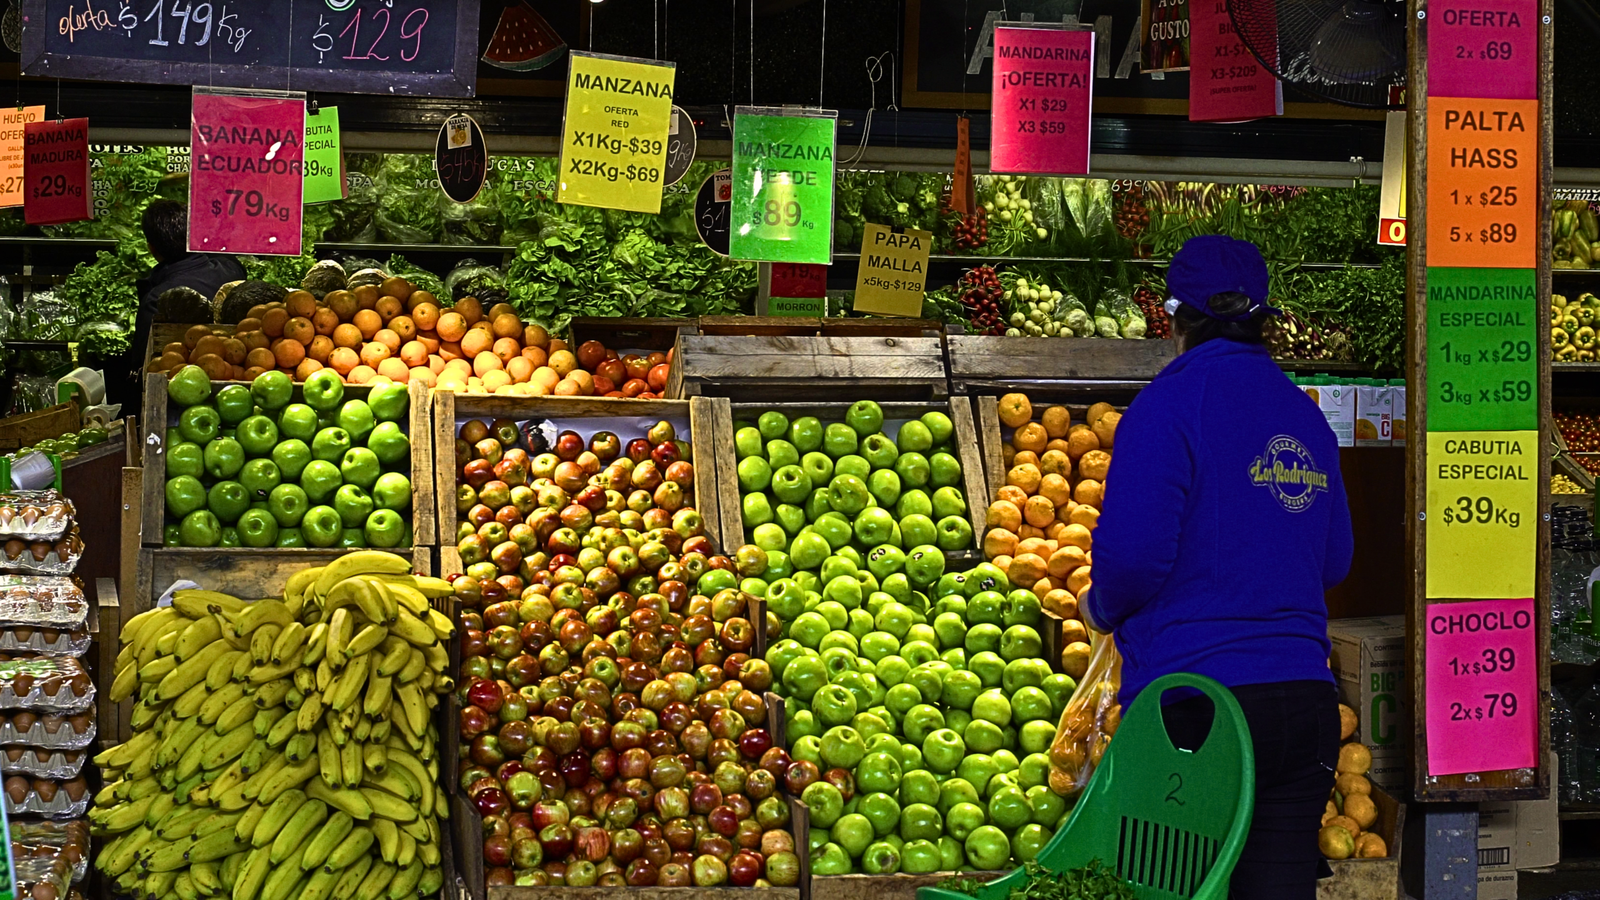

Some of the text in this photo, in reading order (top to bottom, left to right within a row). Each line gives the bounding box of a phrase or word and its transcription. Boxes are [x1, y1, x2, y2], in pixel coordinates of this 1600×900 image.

[59, 0, 117, 42] oferta
[217, 5, 252, 52] Kg
[1443, 9, 1521, 27] OFERTA
[312, 8, 429, 64] $129
[1150, 19, 1190, 41] GUSTO
[999, 46, 1091, 61] MANDARINA
[1480, 42, 1512, 60] $69
[1002, 71, 1087, 89] ¡OFERTA!
[1211, 66, 1257, 80] X3-$209
[575, 73, 673, 99] MANZANA
[604, 106, 639, 116] OFERTA
[1019, 97, 1067, 113] X1 $29
[3, 113, 36, 124] HUEVO
[611, 120, 630, 128] RED
[1445, 110, 1525, 132] PALTA
[27, 128, 84, 146] BANANA
[198, 125, 298, 147] BANANA
[306, 125, 333, 135] BUTIA
[1018, 120, 1066, 136] X3 $59
[573, 131, 662, 156] X1Kg-$39
[739, 142, 833, 161] MANZANA
[30, 150, 83, 165] MADURA
[197, 155, 303, 175] ECUADOR
[1451, 148, 1518, 169] HASS
[570, 158, 659, 182] X2Kg-$69
[1450, 187, 1518, 208] 1 x $25
[875, 231, 922, 251] PAPA
[1450, 223, 1518, 245] 5 x $89
[868, 254, 922, 274] MALLA
[863, 276, 922, 292] x5kg-$129
[1430, 286, 1536, 302] MANDARINA
[776, 302, 820, 312] MORRON
[1440, 312, 1526, 327] ESPECIAL
[1381, 420, 1390, 437] C
[1445, 440, 1523, 455] CABUTIA
[1438, 464, 1529, 480] ESPECIAL
[1431, 610, 1532, 635] CHOCLO
[1371, 672, 1396, 692] BIG
[1371, 693, 1397, 745] C
[1165, 773, 1186, 805] 2
[1493, 874, 1515, 882] durazno
